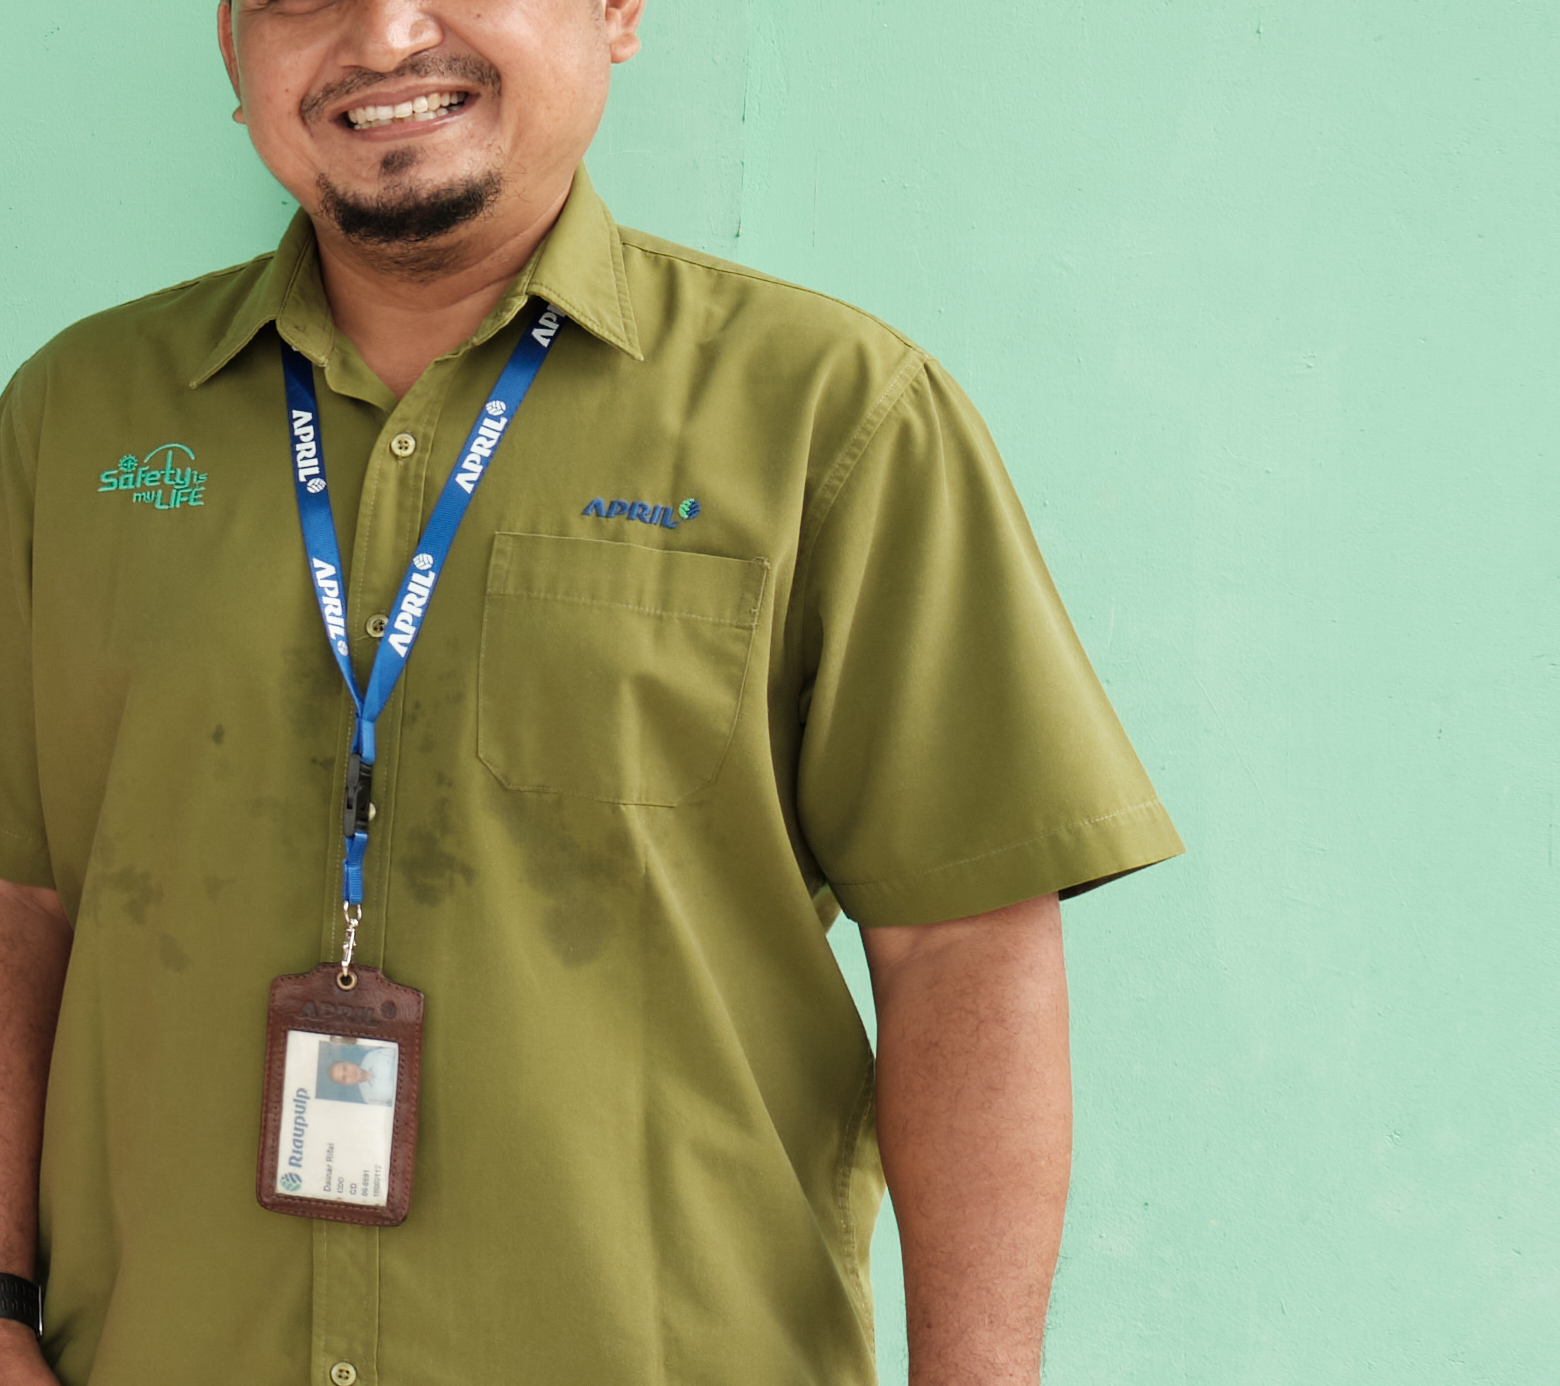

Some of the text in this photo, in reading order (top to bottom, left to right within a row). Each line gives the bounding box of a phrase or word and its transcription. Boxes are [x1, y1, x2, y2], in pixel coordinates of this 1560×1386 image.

[292, 409, 321, 483] APRIL
[455, 416, 508, 494] APRIL
[581, 497, 679, 530] APRIL
[312, 557, 345, 641] APRIL
[388, 570, 436, 658] APRIL
[288, 1087, 308, 1168] Riaupulp
